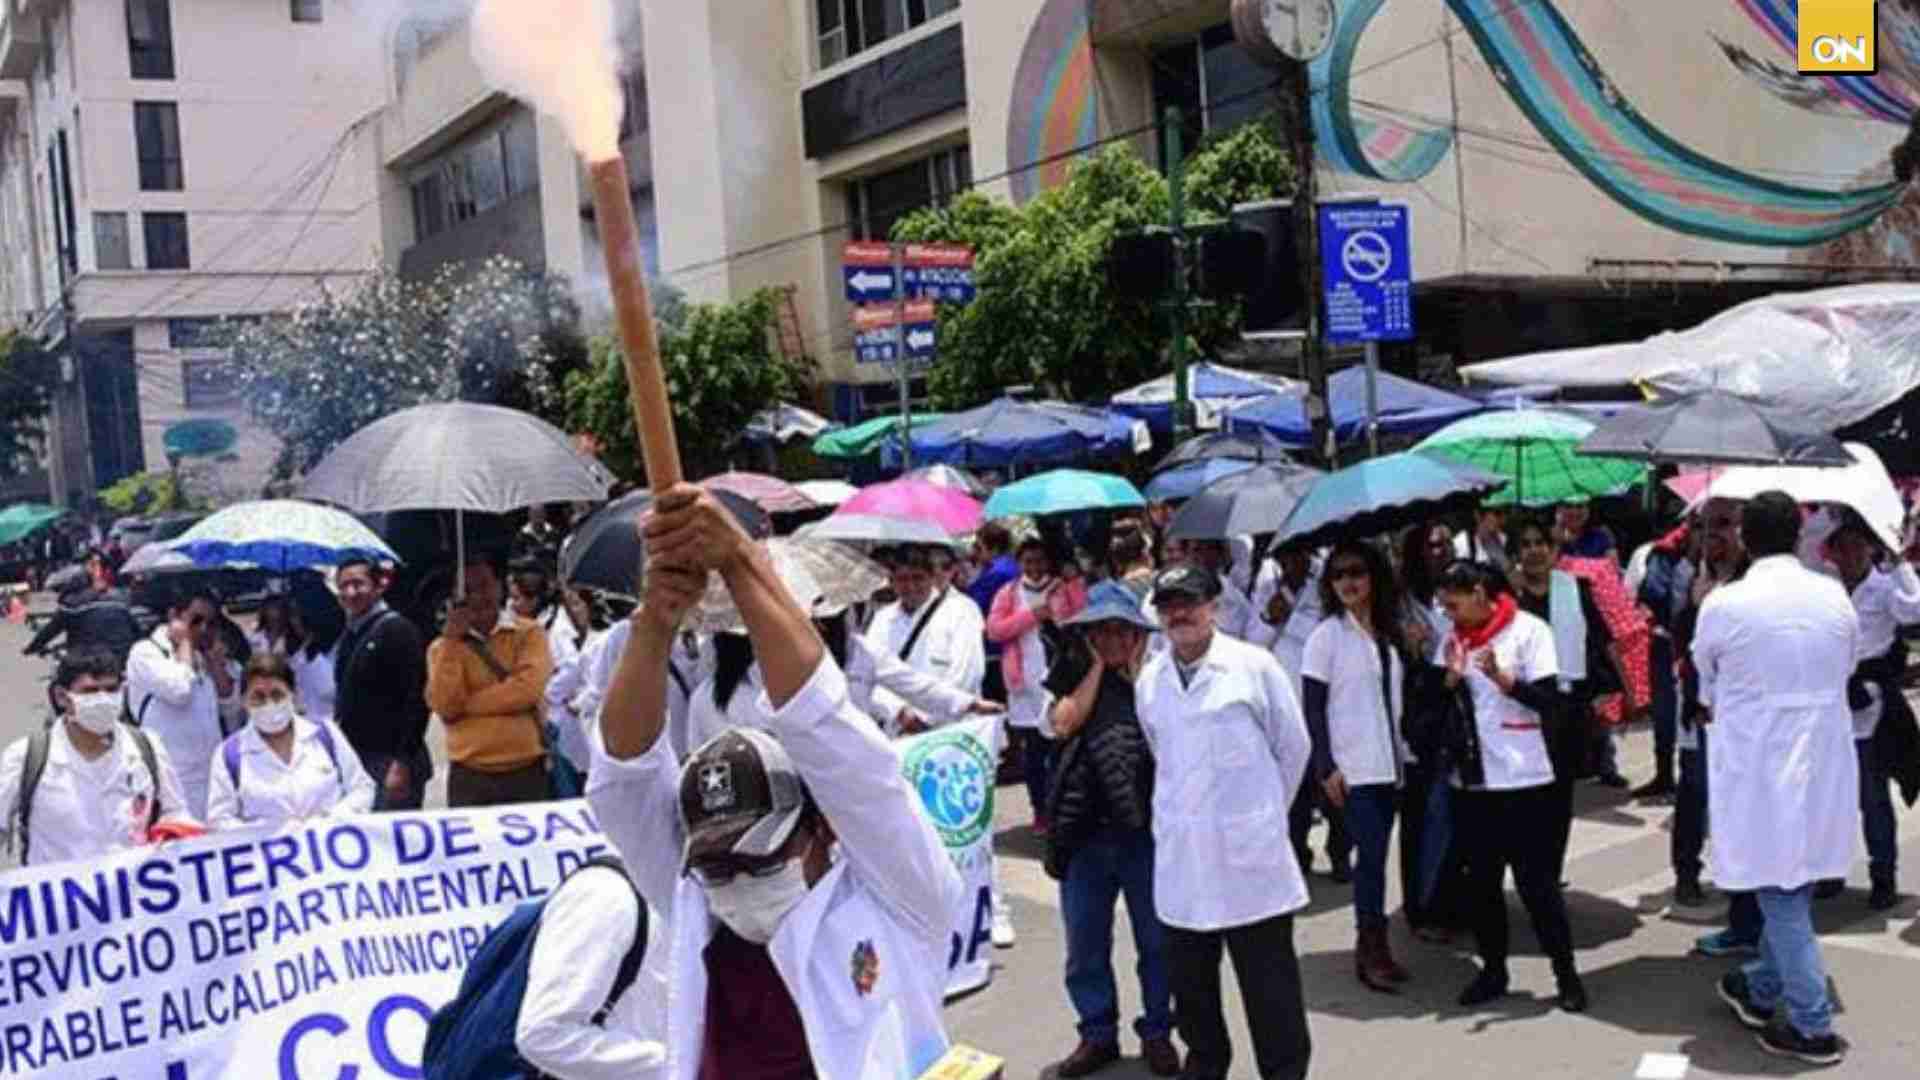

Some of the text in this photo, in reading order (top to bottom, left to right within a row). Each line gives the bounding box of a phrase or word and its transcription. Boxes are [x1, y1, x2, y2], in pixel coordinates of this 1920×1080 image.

[0, 824, 371, 943] MINISTERIO
[393, 817, 479, 865] DE
[0, 926, 175, 1007] RVICIO
[188, 857, 548, 964] DEPARTAMENTAL
[0, 922, 492, 1073] RABLE ALCALDIA MUNICIP
